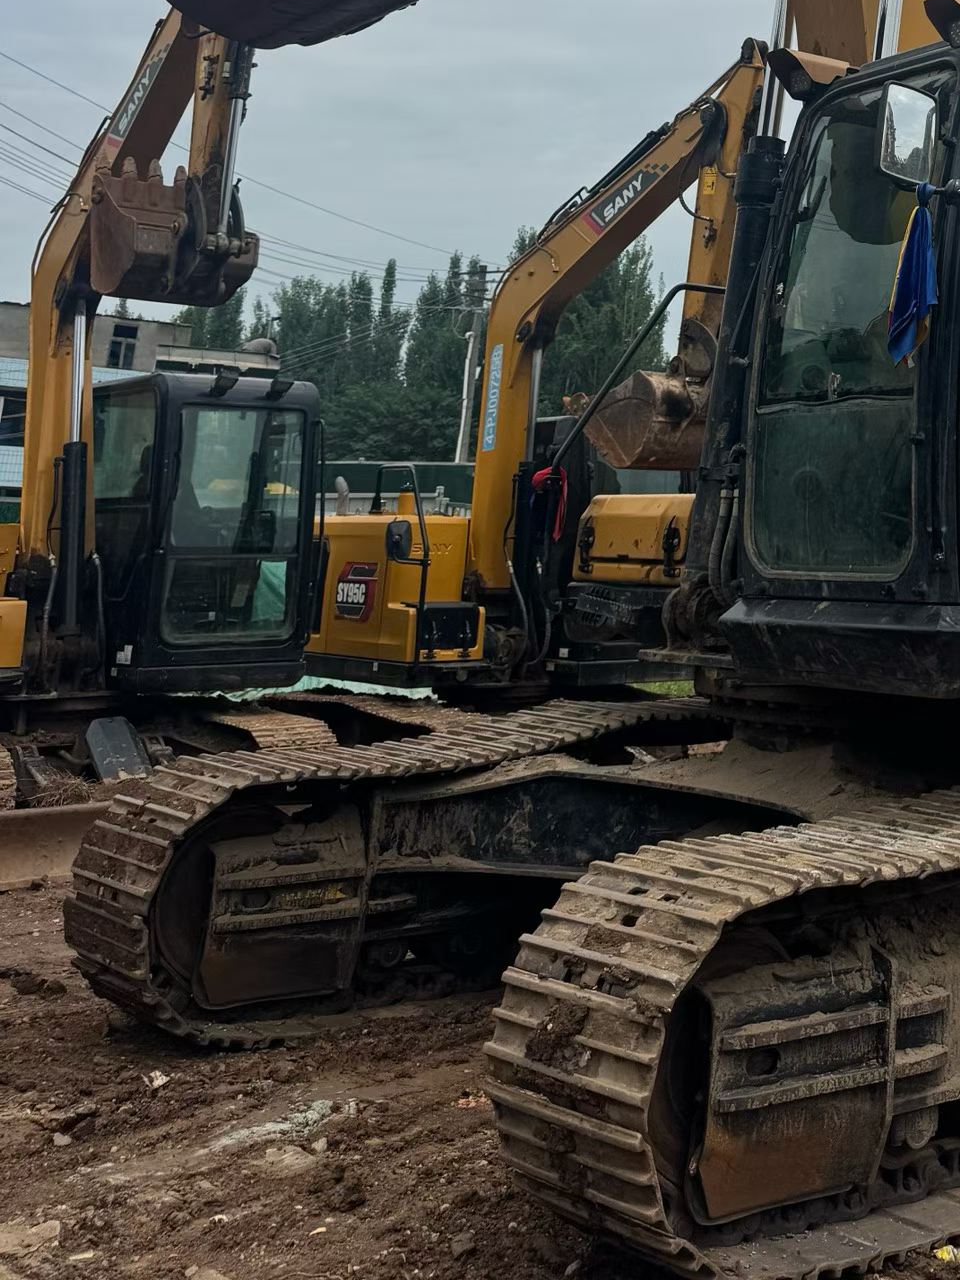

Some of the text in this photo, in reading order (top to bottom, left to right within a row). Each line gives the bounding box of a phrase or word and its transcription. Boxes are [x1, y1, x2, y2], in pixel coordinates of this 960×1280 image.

[118, 67, 150, 135] SANY
[603, 173, 643, 223] SANY
[411, 543, 453, 556] SNY
[336, 582, 367, 603] SY95C
